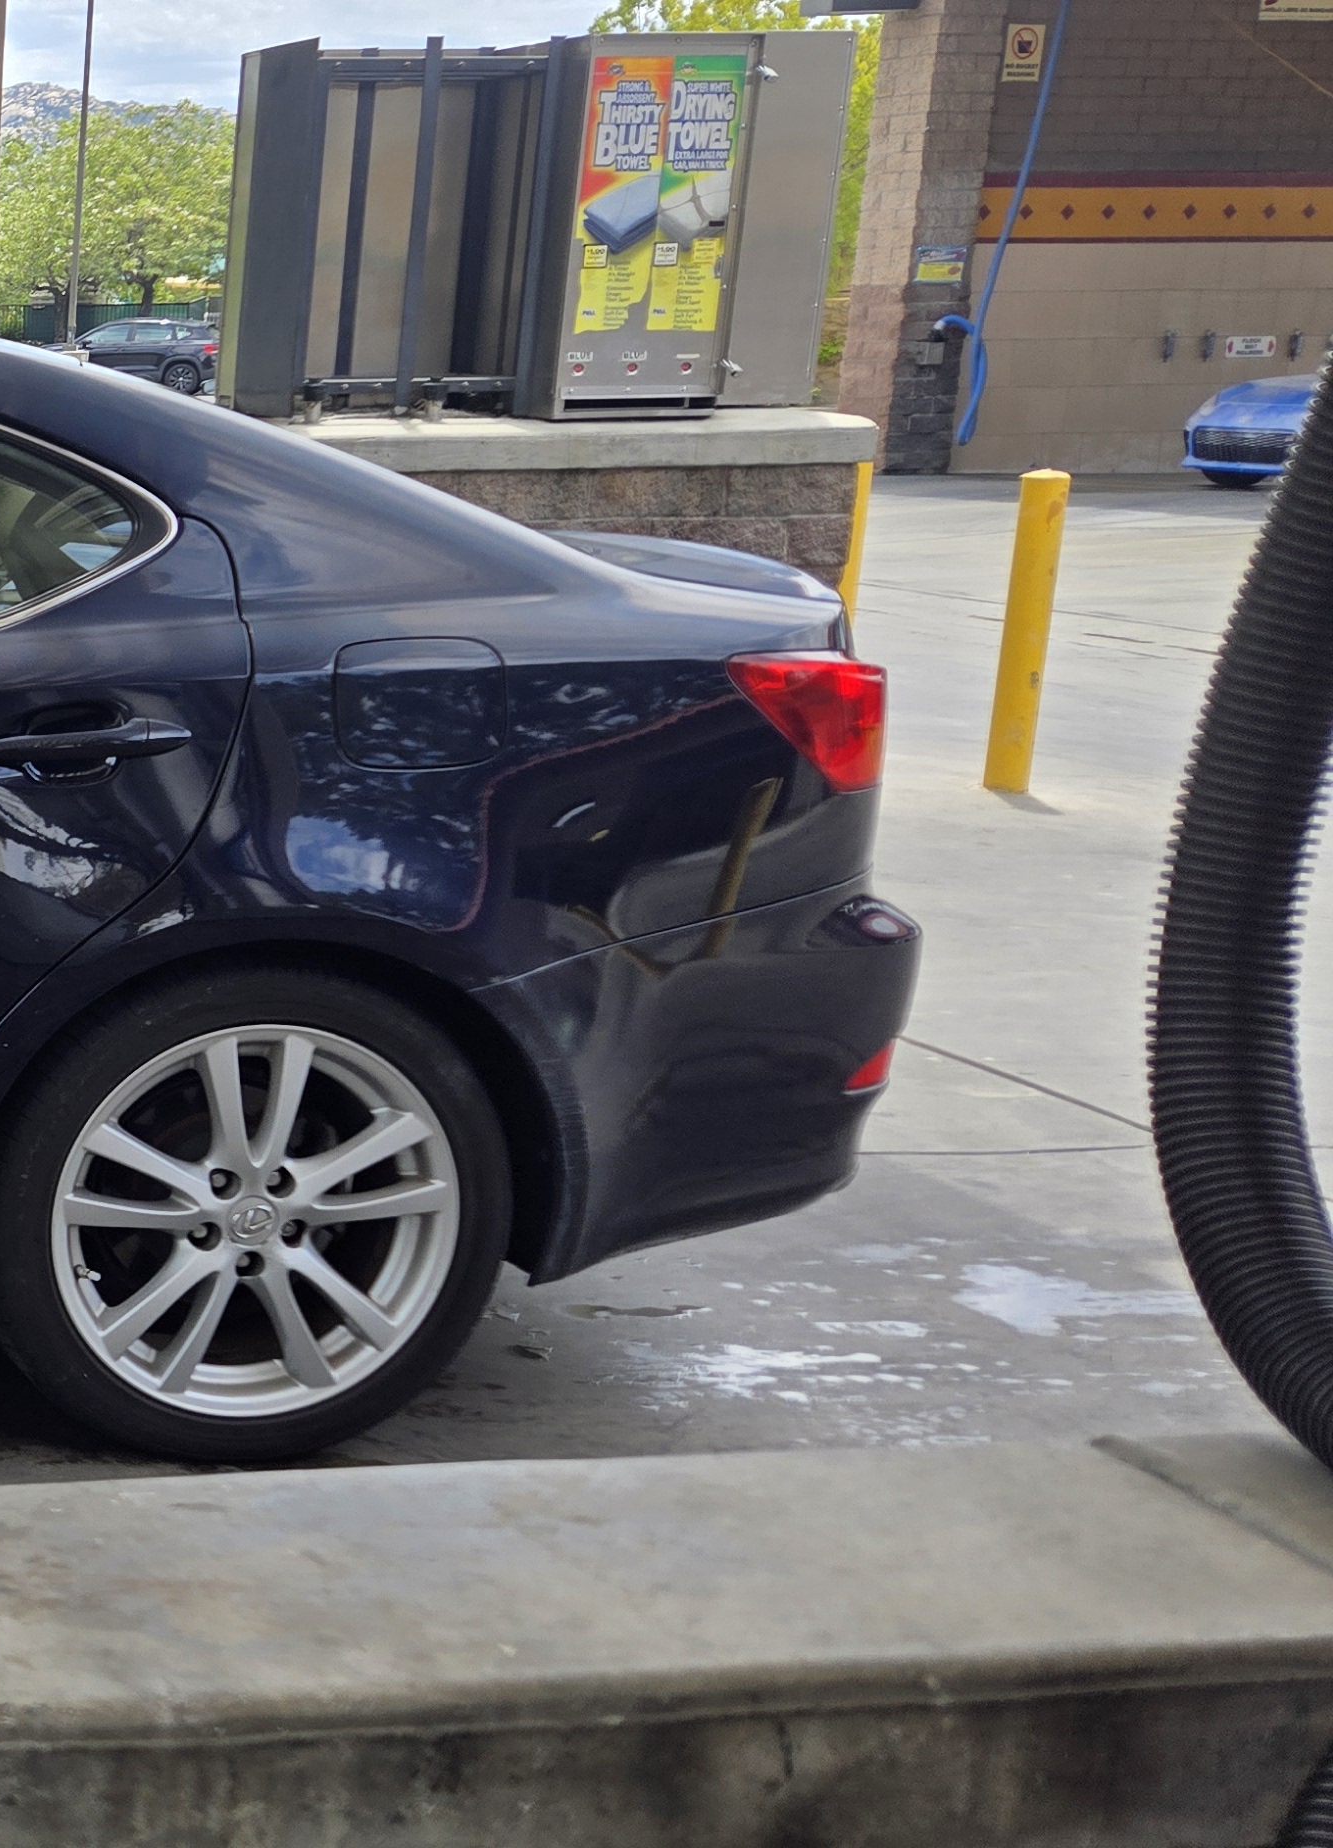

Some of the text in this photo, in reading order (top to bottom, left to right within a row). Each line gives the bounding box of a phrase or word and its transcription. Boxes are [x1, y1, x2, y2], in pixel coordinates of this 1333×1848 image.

[617, 82, 645, 92] STRONG
[687, 81, 731, 92] SUPER WHITE
[616, 93, 656, 103] ABSORBENT
[669, 80, 735, 121] DRYING
[600, 92, 663, 124] THIRSTY
[594, 124, 659, 166] BLUE
[667, 121, 730, 161] TOWEL
[675, 150, 728, 159] EXTRA LARGE FOR
[616, 155, 650, 169] TOWEL
